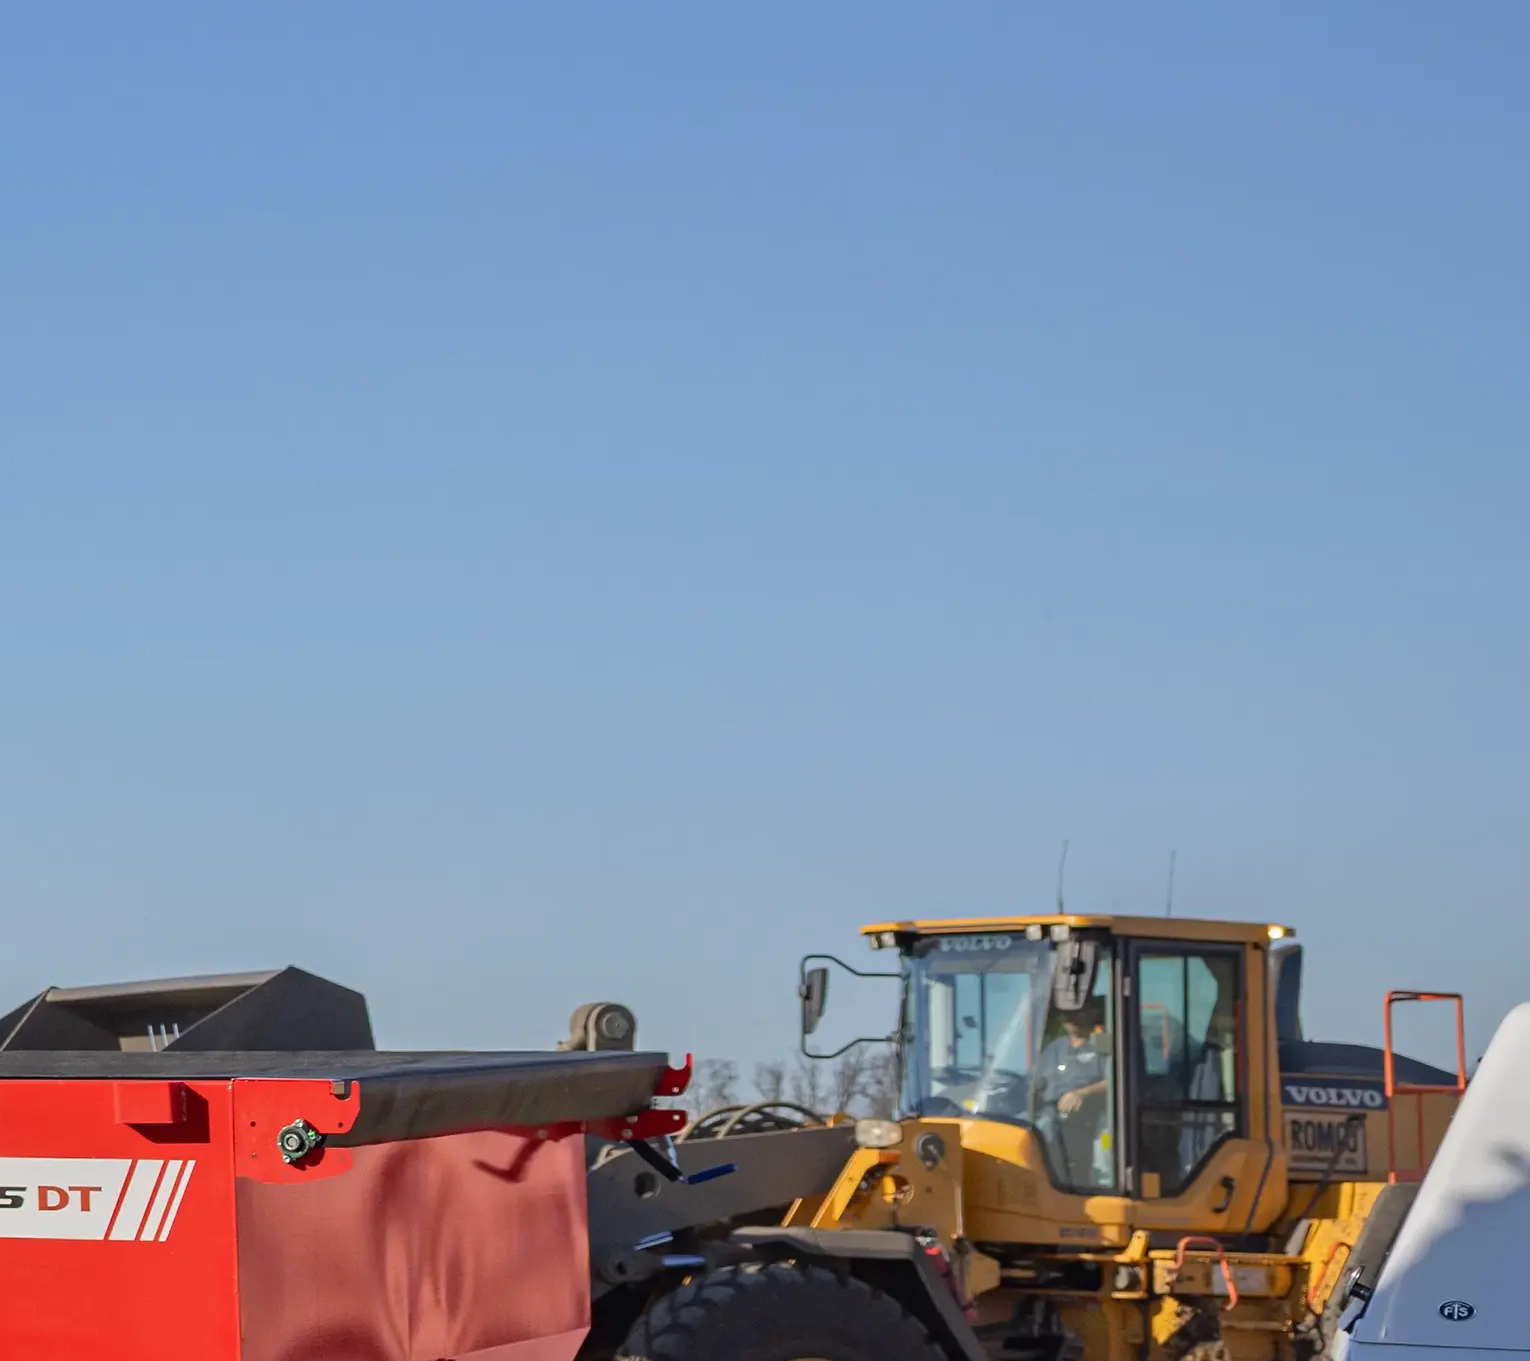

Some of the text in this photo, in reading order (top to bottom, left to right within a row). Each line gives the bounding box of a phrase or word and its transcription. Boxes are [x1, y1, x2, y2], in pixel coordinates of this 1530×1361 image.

[939, 936, 1012, 952] VOLVO
[1285, 1085, 1383, 1107] VOLVO
[37, 1185, 102, 1212] DT
